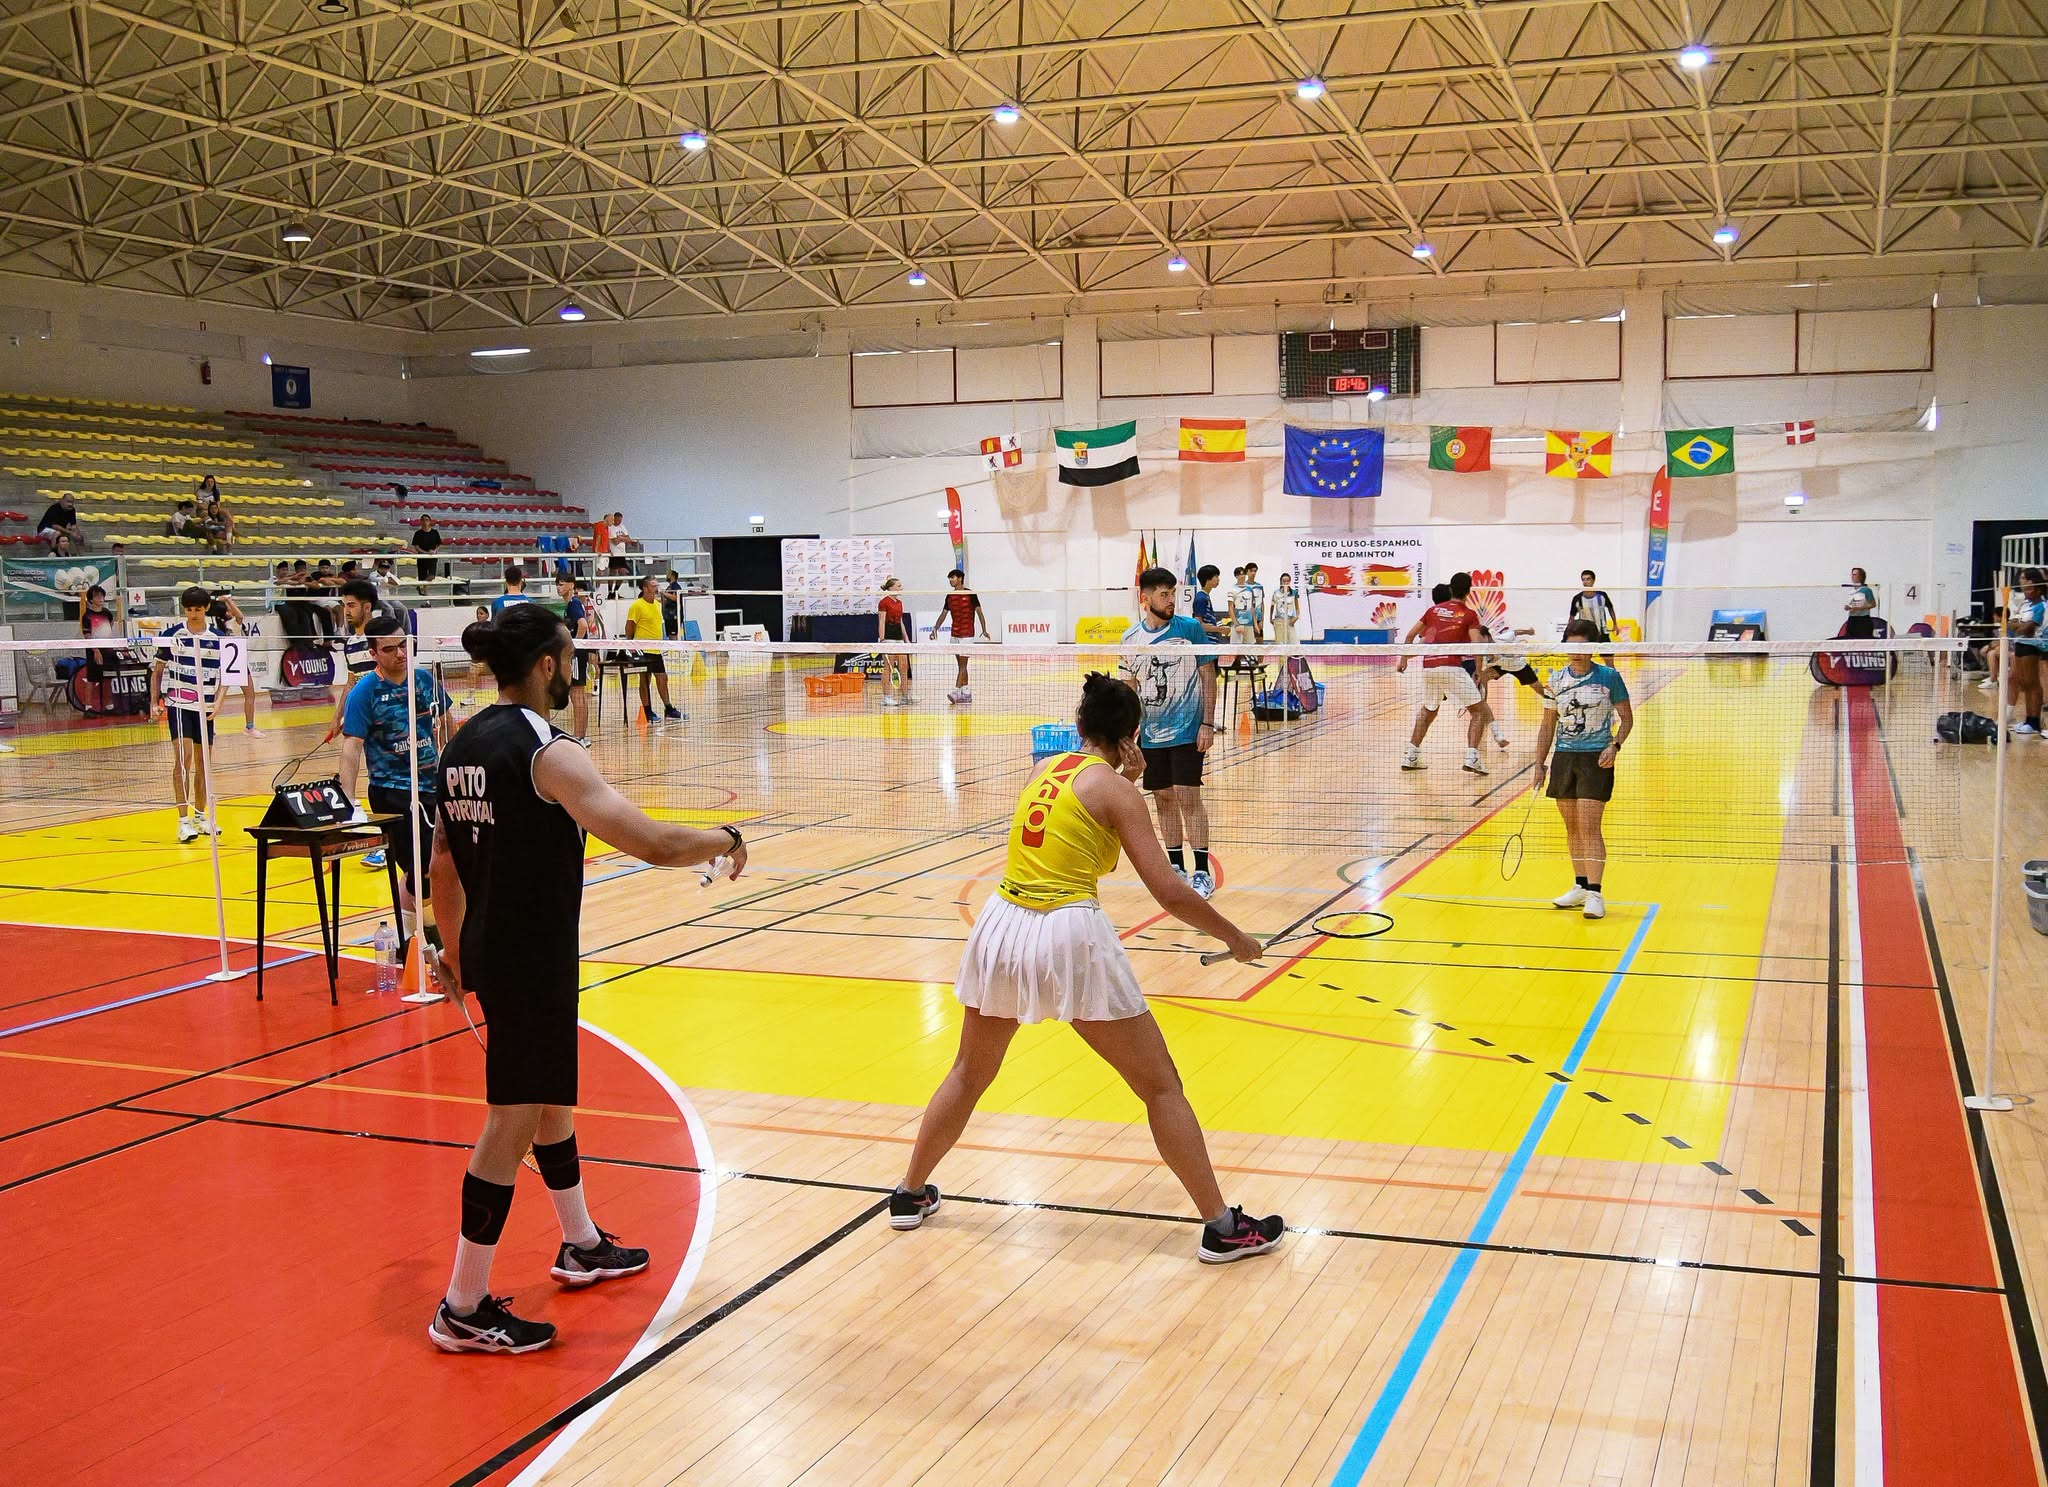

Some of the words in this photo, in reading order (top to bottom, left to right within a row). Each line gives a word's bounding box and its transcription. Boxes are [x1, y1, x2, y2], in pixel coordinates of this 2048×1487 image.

[1335, 377, 1366, 391] 18:46
[1294, 540, 1338, 548] TORNEIO
[1341, 539, 1423, 548] LUSO-ESPANHOL
[1335, 550, 1395, 558] BADMINTON
[1648, 560, 1664, 579] 27
[595, 594, 603, 606] 6
[1184, 589, 1192, 602] 5
[1907, 586, 1917, 600] 4
[1008, 623, 1027, 633] FAIR
[1030, 623, 1050, 633] PLAY
[224, 642, 241, 674] 2
[300, 658, 329, 675] YOUNG
[446, 766, 486, 797] PITO
[286, 792, 306, 814] 7
[322, 787, 345, 809] 2
